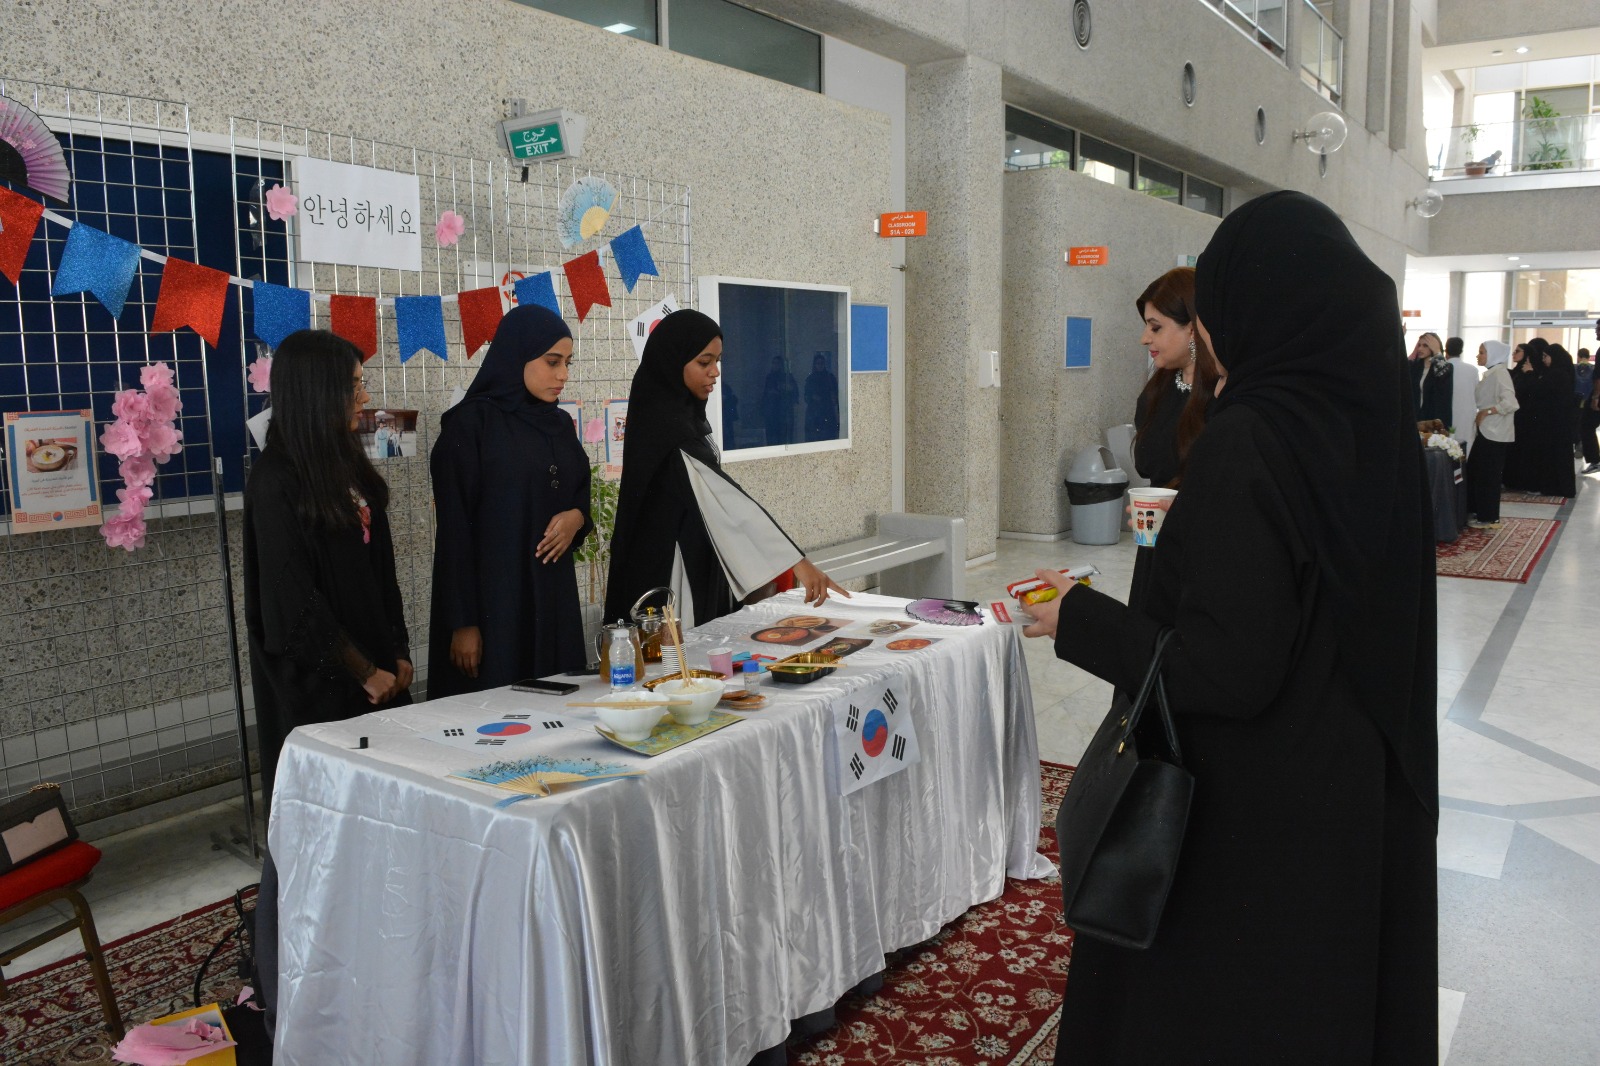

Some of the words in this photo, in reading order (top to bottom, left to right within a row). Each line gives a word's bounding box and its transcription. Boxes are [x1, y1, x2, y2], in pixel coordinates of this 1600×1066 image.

[523, 127, 546, 143] خروج
[525, 143, 549, 156] EXIT
[303, 193, 417, 236] 안녕하세요
